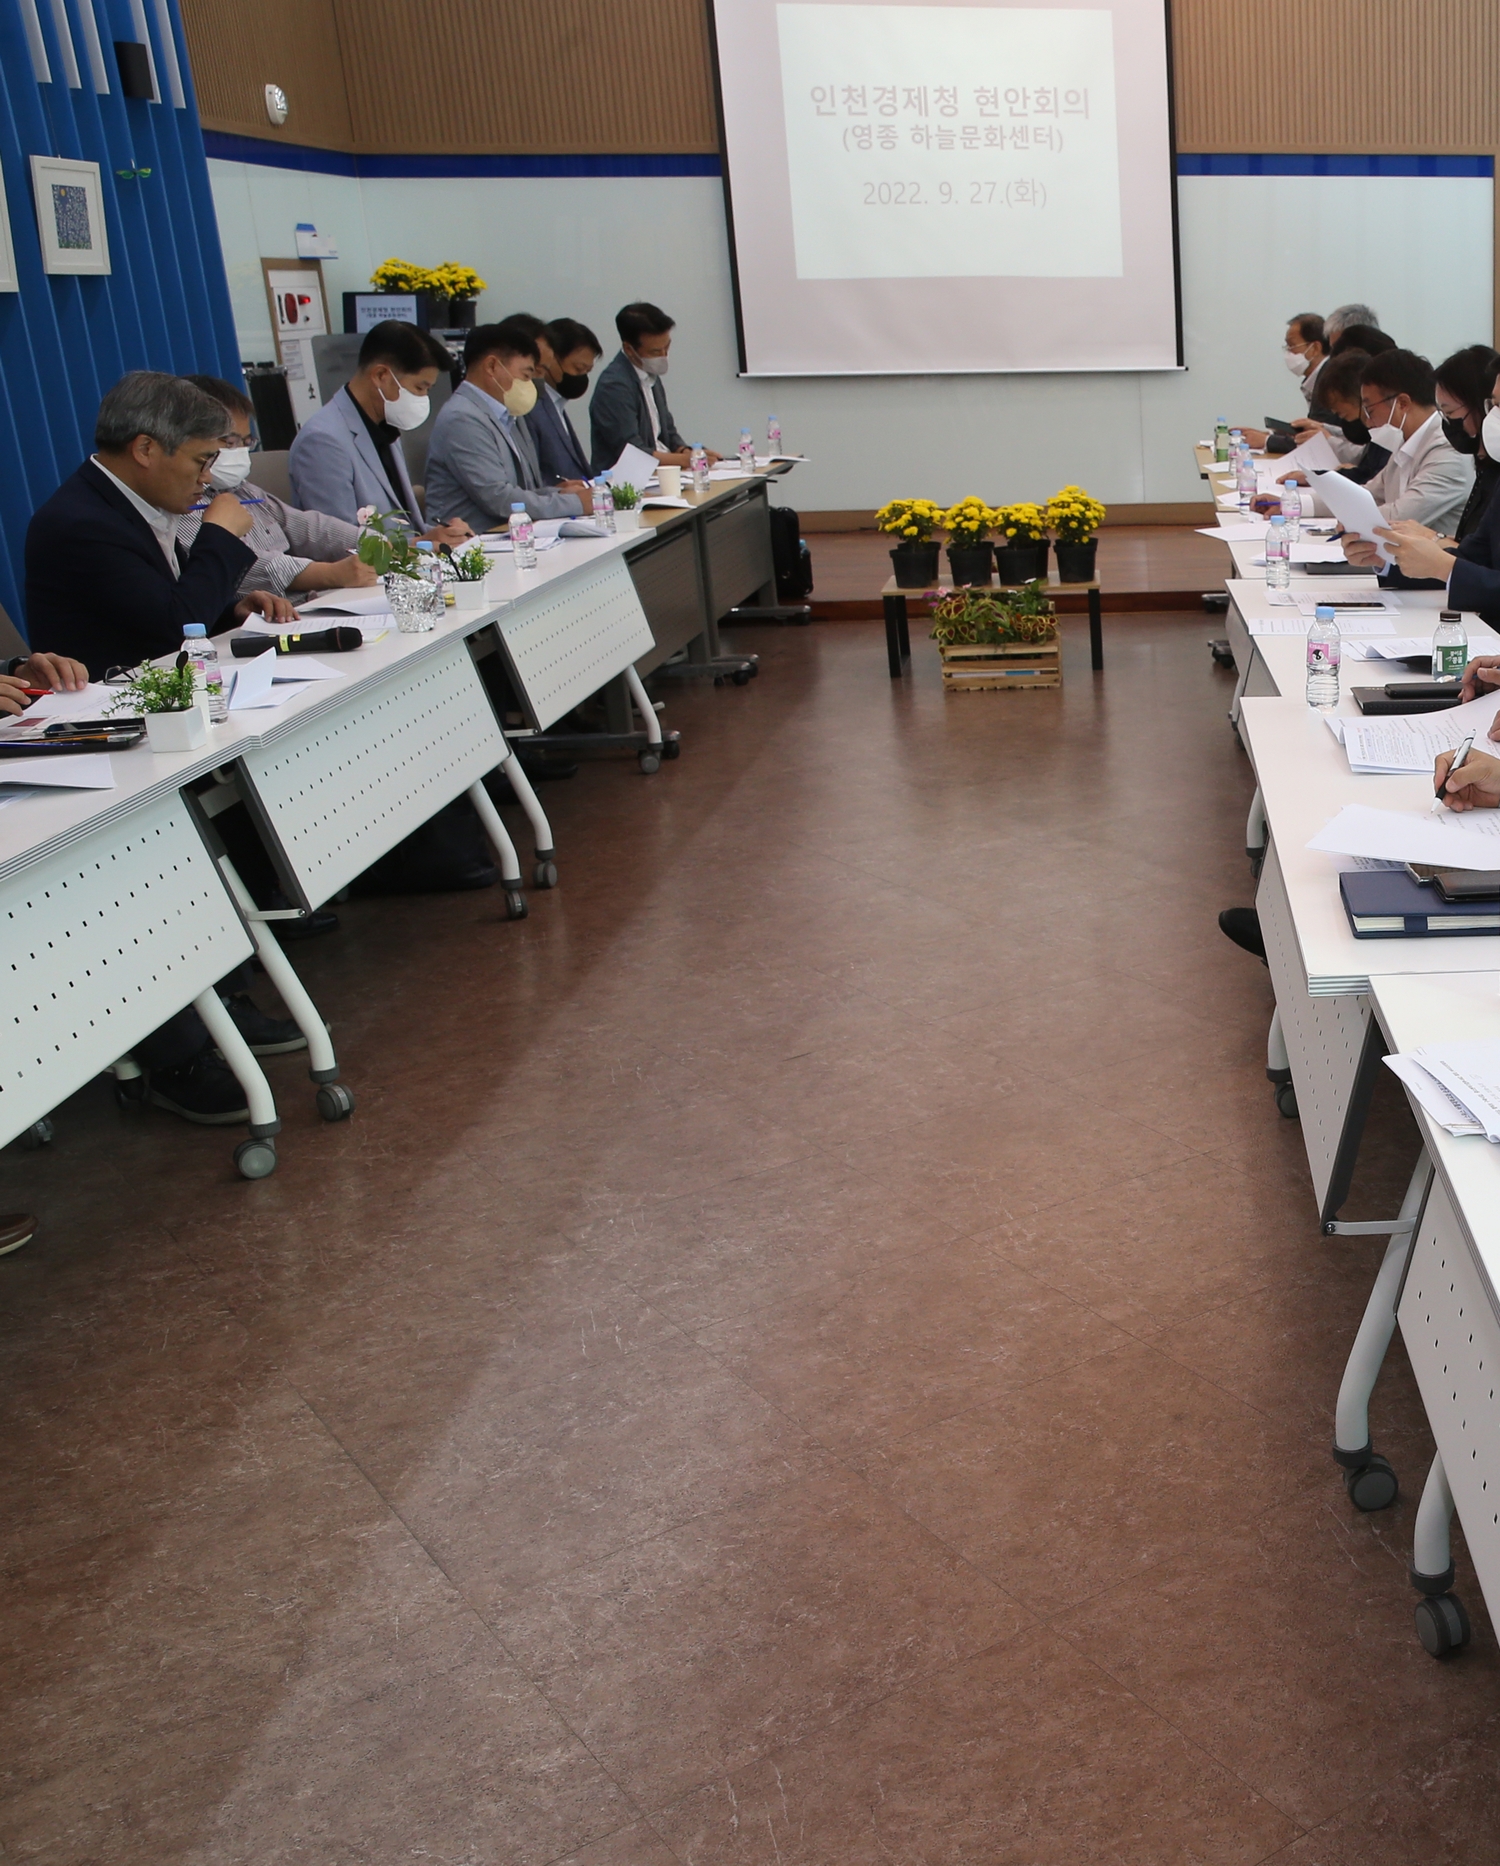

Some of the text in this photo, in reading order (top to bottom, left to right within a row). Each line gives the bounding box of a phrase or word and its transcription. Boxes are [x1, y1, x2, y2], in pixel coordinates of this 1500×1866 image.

[810, 84, 1090, 119] 인천경제청 현안회의
[842, 124, 1064, 153] (영종 하늘문화센터)
[863, 178, 1047, 208] 2022. 9. 27.(화)
